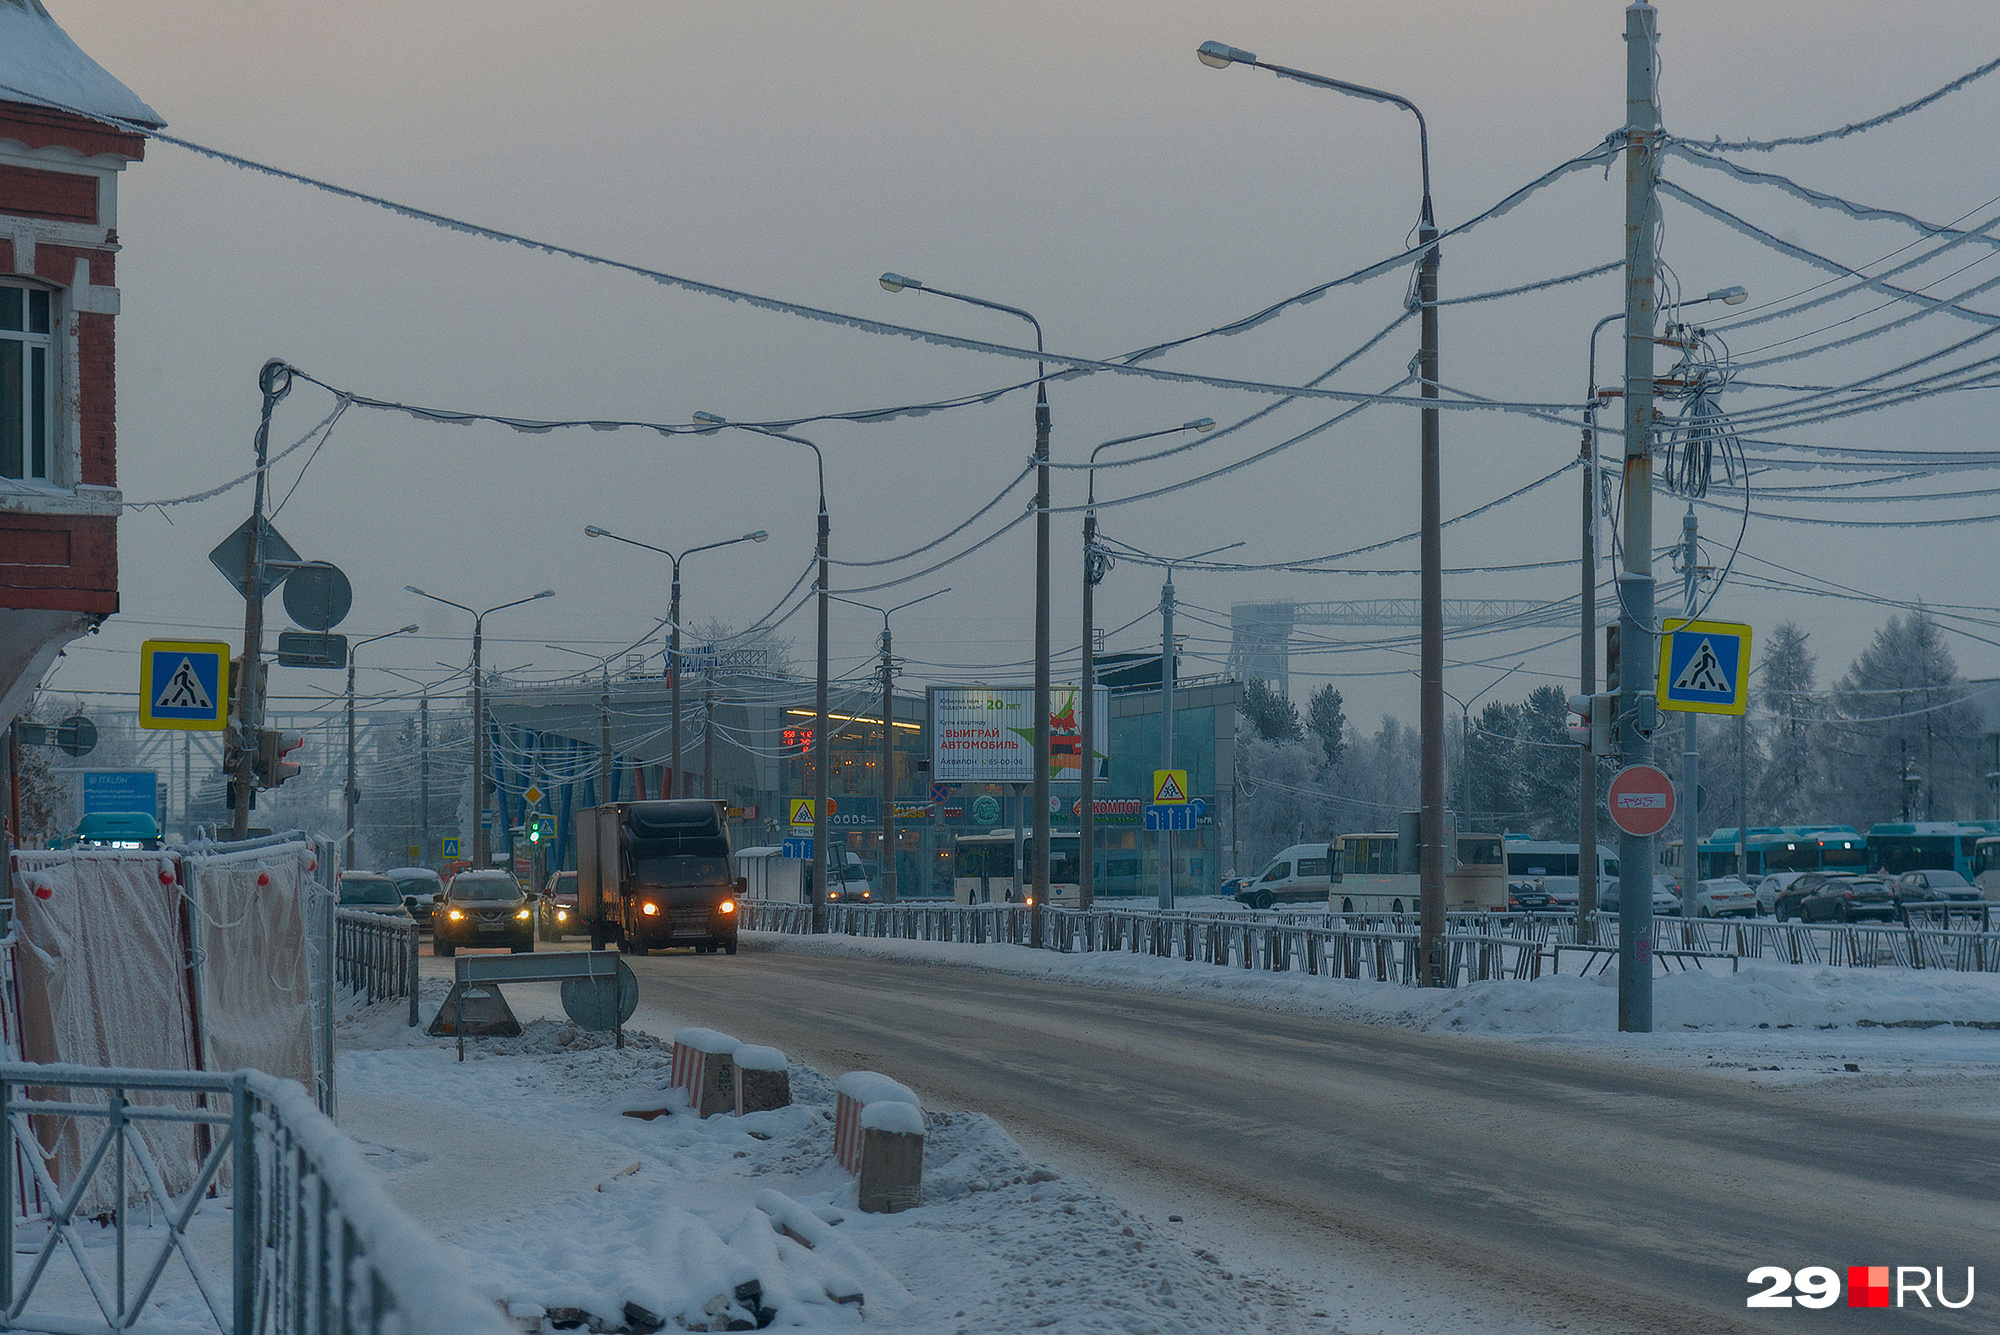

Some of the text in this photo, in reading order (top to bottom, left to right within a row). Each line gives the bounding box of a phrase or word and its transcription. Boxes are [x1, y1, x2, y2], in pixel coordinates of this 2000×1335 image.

[987, 699, 1004, 710] 20
[945, 728, 1000, 738] ВЫИГРАЙ
[940, 741, 1019, 750] АВТОМОБИЛЬ
[1093, 799, 1141, 815] КОМПОТ
